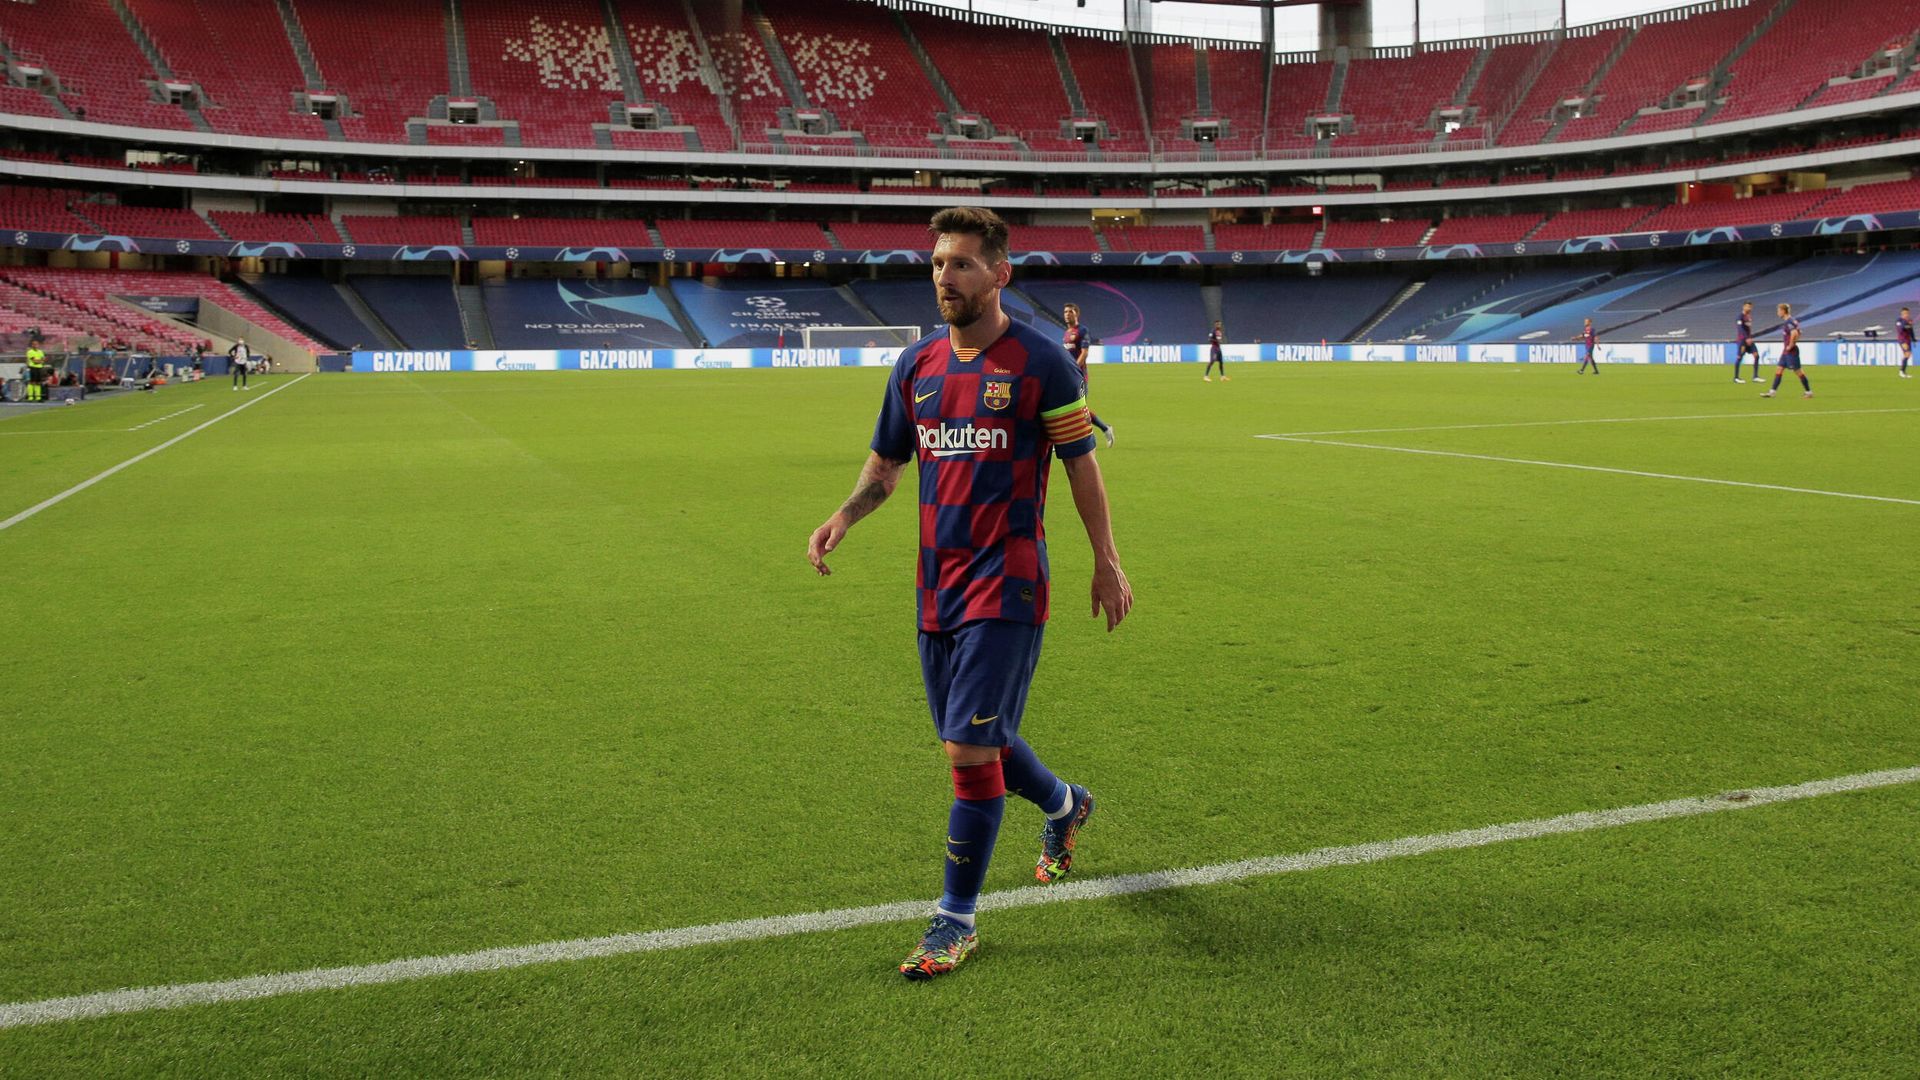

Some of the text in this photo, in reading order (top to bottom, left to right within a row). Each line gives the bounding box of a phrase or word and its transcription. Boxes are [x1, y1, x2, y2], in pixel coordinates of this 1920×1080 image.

[373, 351, 450, 372] GAZPROM
[580, 350, 653, 369] GAZPROM
[771, 349, 840, 367] GAZPROM
[1122, 346, 1181, 363] GAZPROM
[1276, 345, 1333, 362] GAZPROM
[1416, 346, 1457, 362] GAZPROM
[1529, 345, 1576, 363] GAZPROM
[1665, 344, 1724, 364] GAZPROM
[917, 422, 1007, 449] Rakuten
